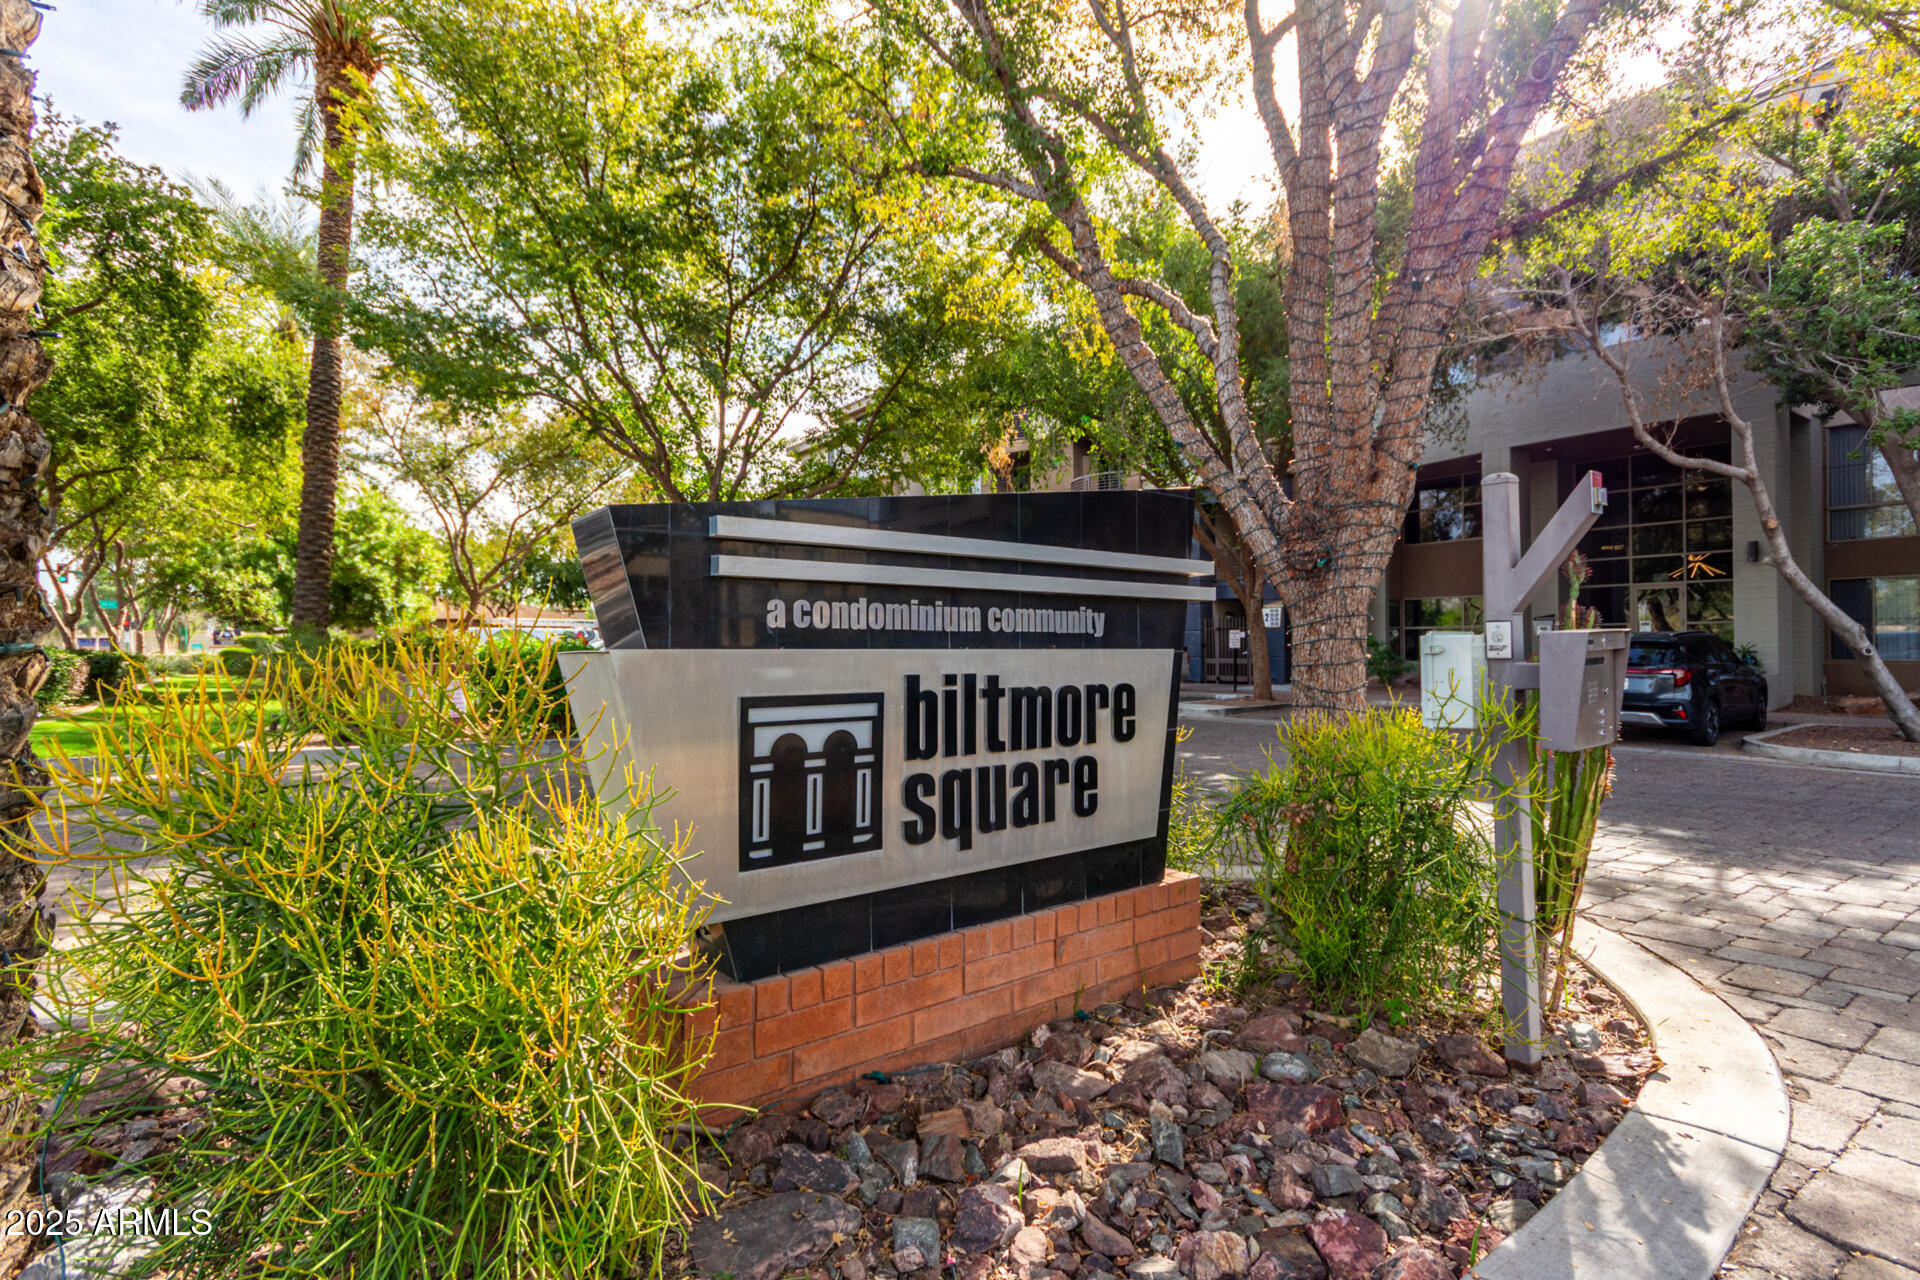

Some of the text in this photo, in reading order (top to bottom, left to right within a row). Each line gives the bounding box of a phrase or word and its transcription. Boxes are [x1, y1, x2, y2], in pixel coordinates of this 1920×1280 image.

[767, 597, 1105, 638] a condominium community
[904, 673, 1136, 761] biltmore
[902, 755, 1099, 851] square
